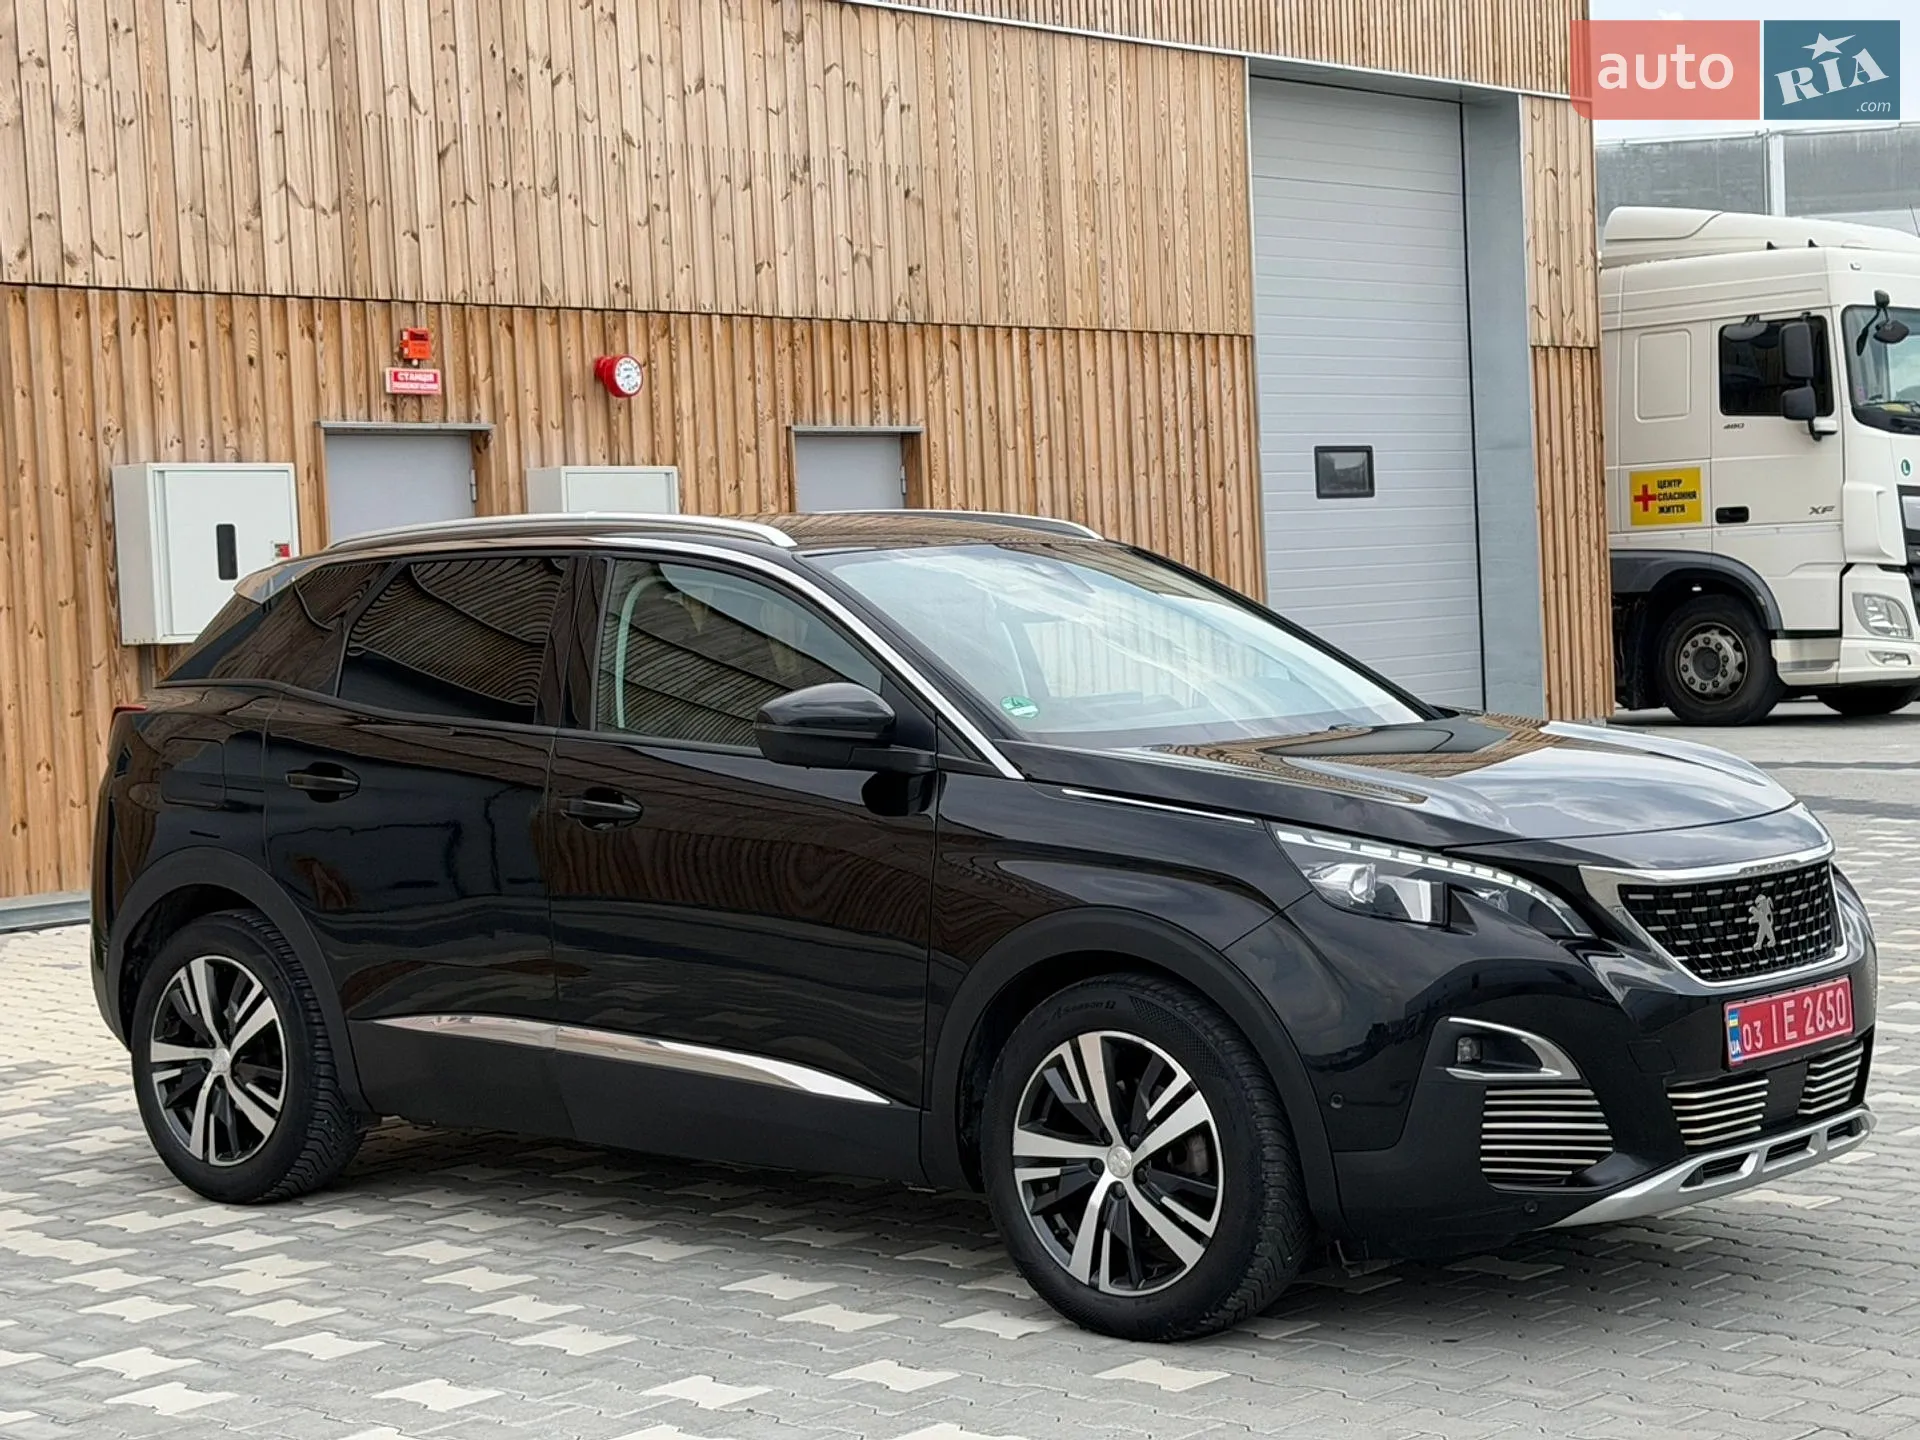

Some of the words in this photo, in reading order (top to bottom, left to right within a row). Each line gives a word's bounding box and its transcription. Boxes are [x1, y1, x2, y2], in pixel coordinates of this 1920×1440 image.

[1657, 479, 1682, 489] ЦЕНТР
[1658, 504, 1685, 514] ЖИТТЯ
[1809, 506, 1835, 515] XF
[1742, 1020, 1763, 1051] 03
[1771, 1000, 1798, 1044] IE
[1803, 987, 1847, 1036] 2650
[1729, 1039, 1742, 1055] UA
